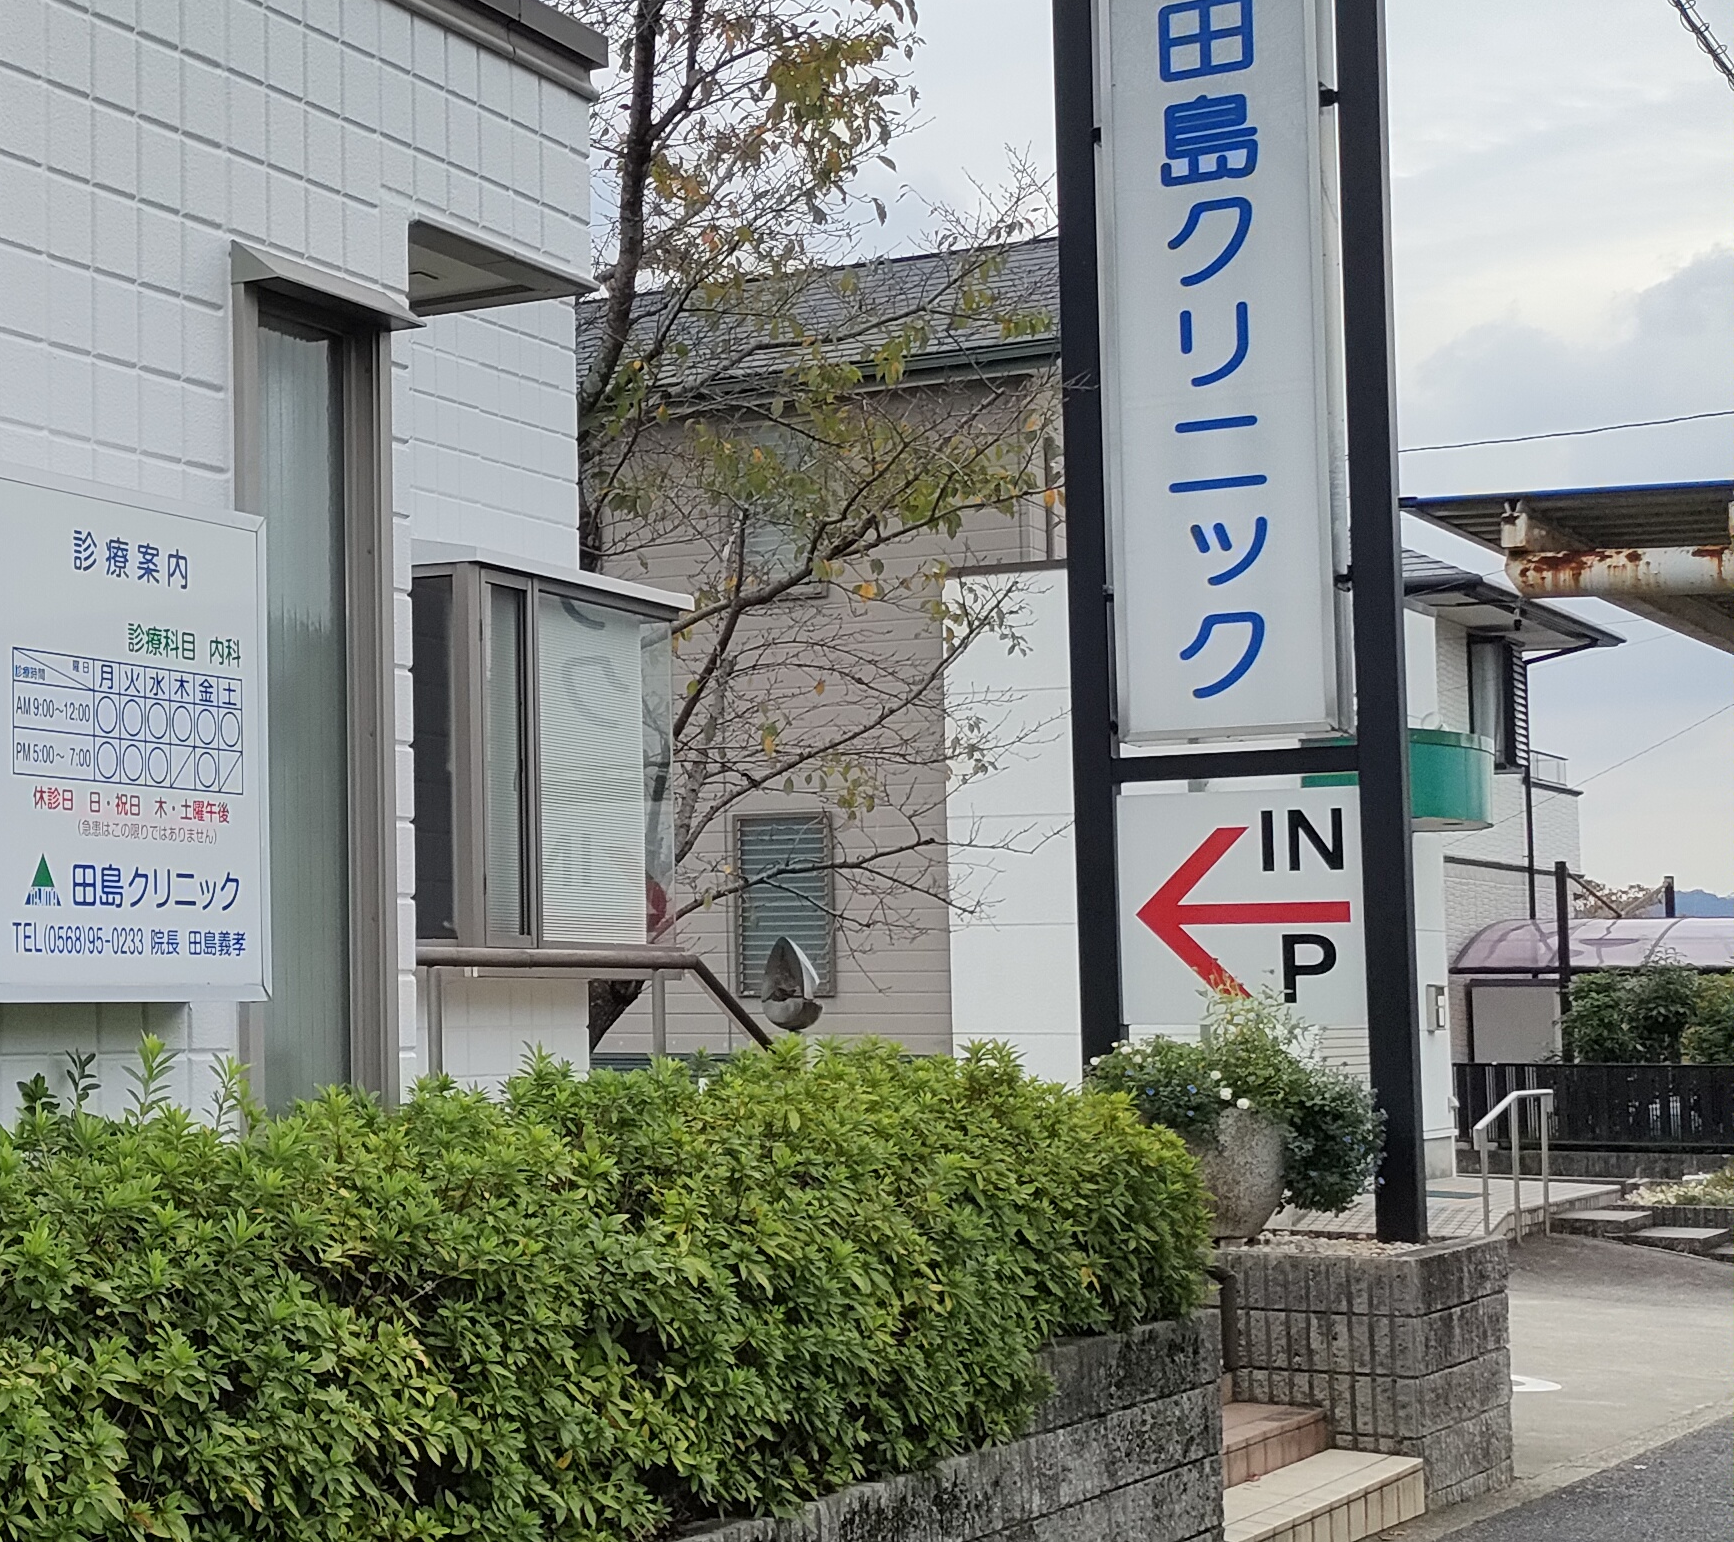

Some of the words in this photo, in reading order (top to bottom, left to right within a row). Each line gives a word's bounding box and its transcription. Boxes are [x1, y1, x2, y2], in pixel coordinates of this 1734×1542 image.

[73, 529, 188, 590] 診療案内
[127, 622, 196, 661] 診療科目
[209, 636, 242, 669] 内科
[98, 663, 114, 690] 月
[124, 667, 141, 694] 火
[149, 671, 166, 697] 水
[173, 674, 191, 700] 木
[198, 678, 215, 704] 金
[222, 681, 238, 707] 土
[16, 695, 31, 716] AM
[16, 741, 31, 762] PM
[33, 785, 74, 811] 休診日
[89, 791, 141, 817] 日・祝日
[154, 797, 230, 825] 木・土曜午後
[1260, 807, 1344, 872] IN
[72, 863, 240, 912] 田島クリニック
[12, 921, 144, 955] TEL(0568)95-0233
[150, 928, 180, 956] 院長
[188, 929, 247, 957] 田島義孝
[1281, 933, 1337, 1004] P
